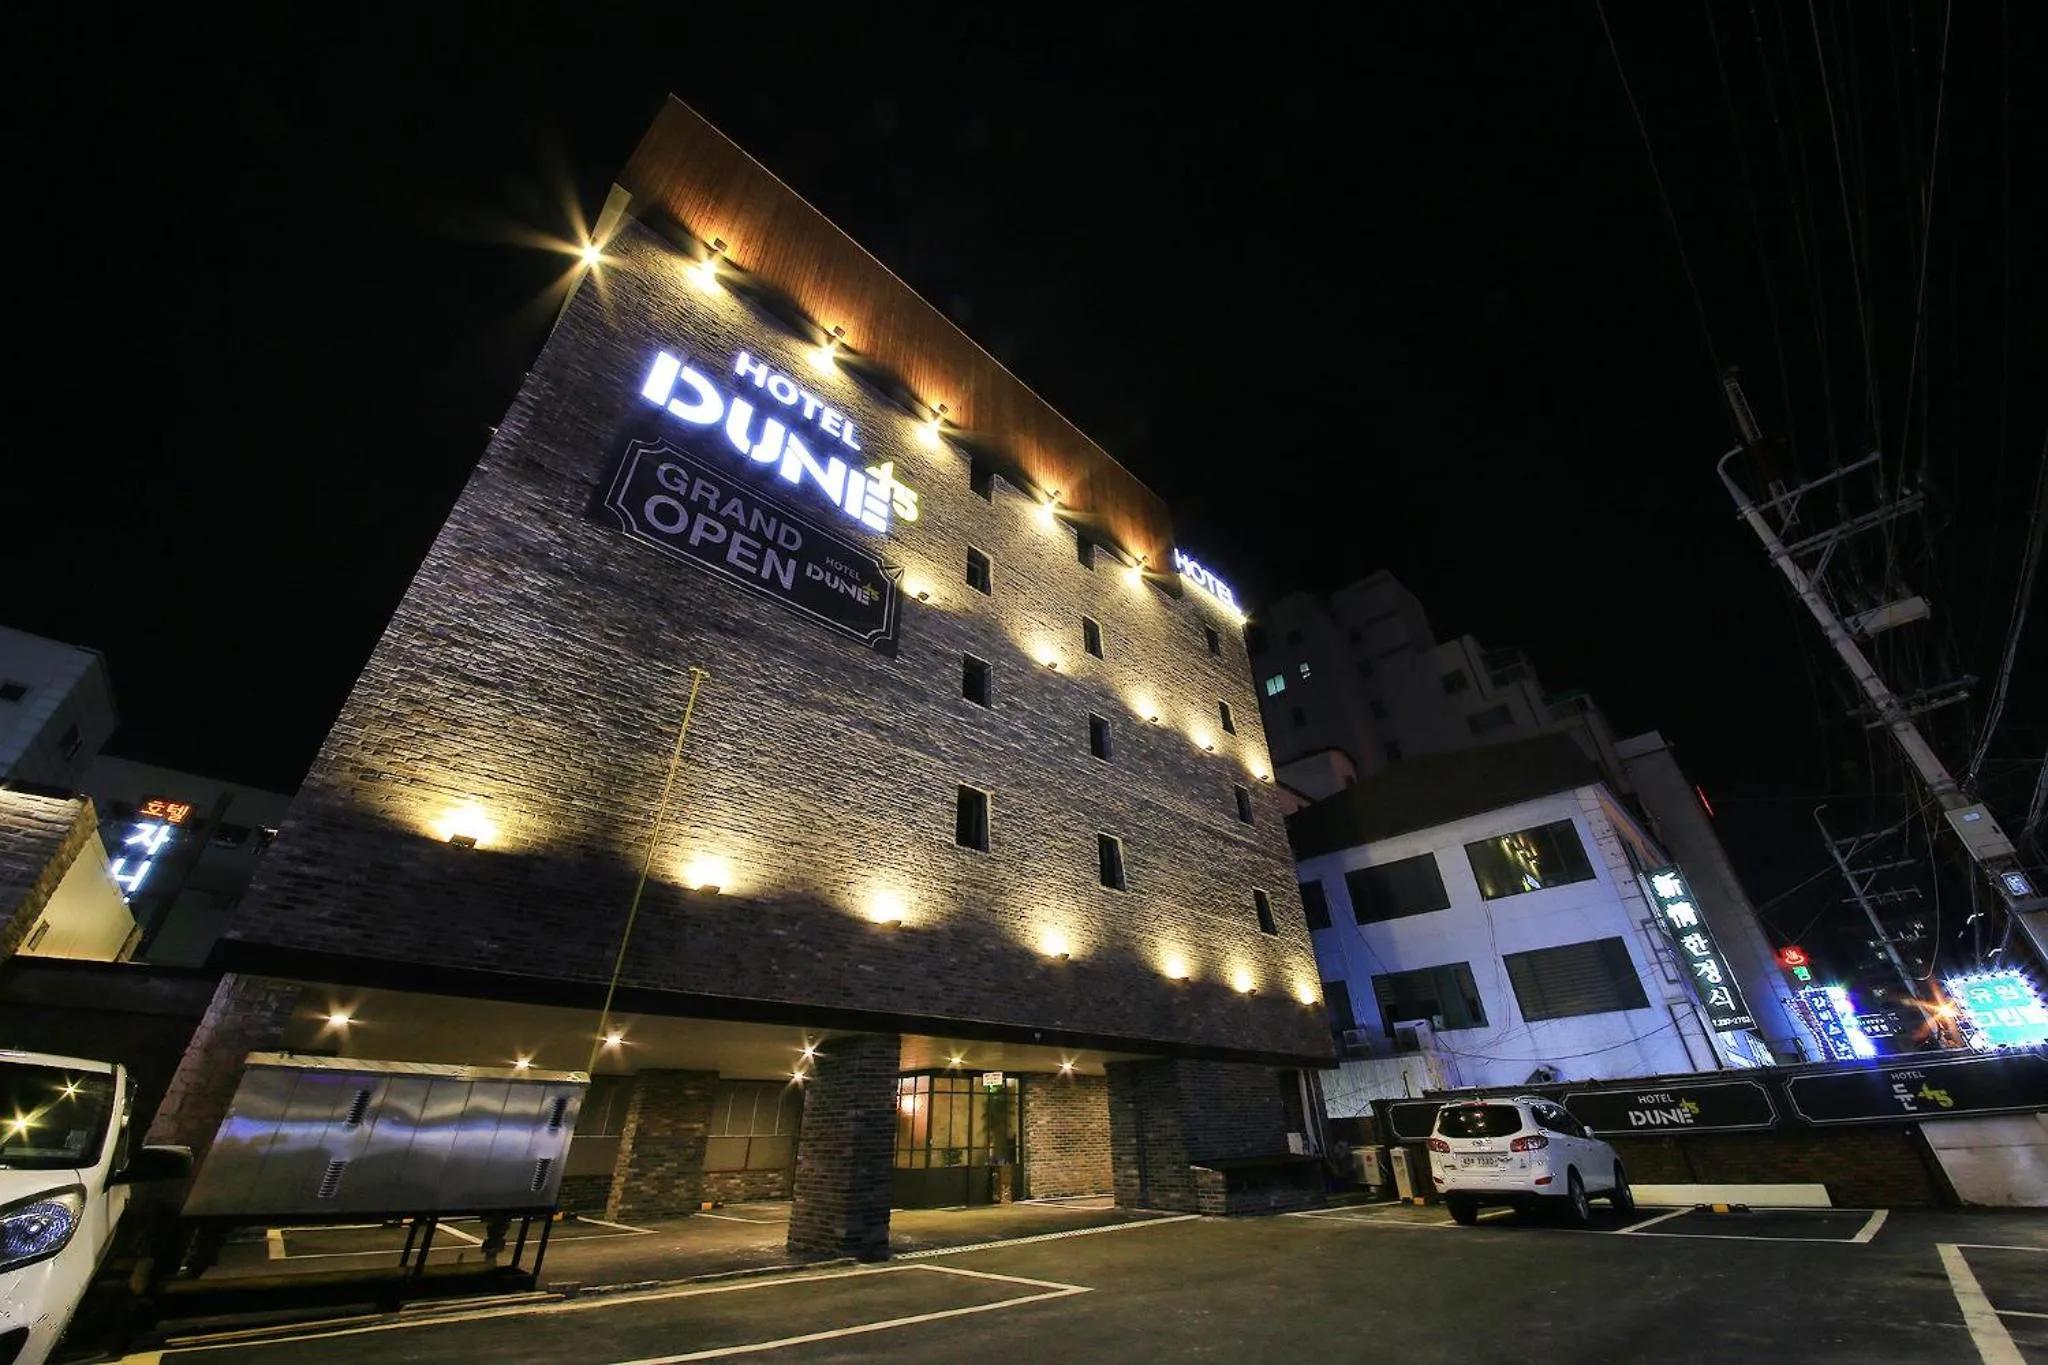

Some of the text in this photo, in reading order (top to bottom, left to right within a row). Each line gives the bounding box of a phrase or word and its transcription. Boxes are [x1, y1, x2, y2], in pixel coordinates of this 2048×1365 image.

[733, 350, 861, 451] HOTEL
[656, 462, 803, 552] GRAND
[643, 494, 797, 591] OPEN
[825, 556, 861, 582] HOTEL
[1173, 547, 1242, 616] HOTEL
[1637, 1093, 1676, 1104] HOTEL
[1890, 1070, 1926, 1080] HOTEL
